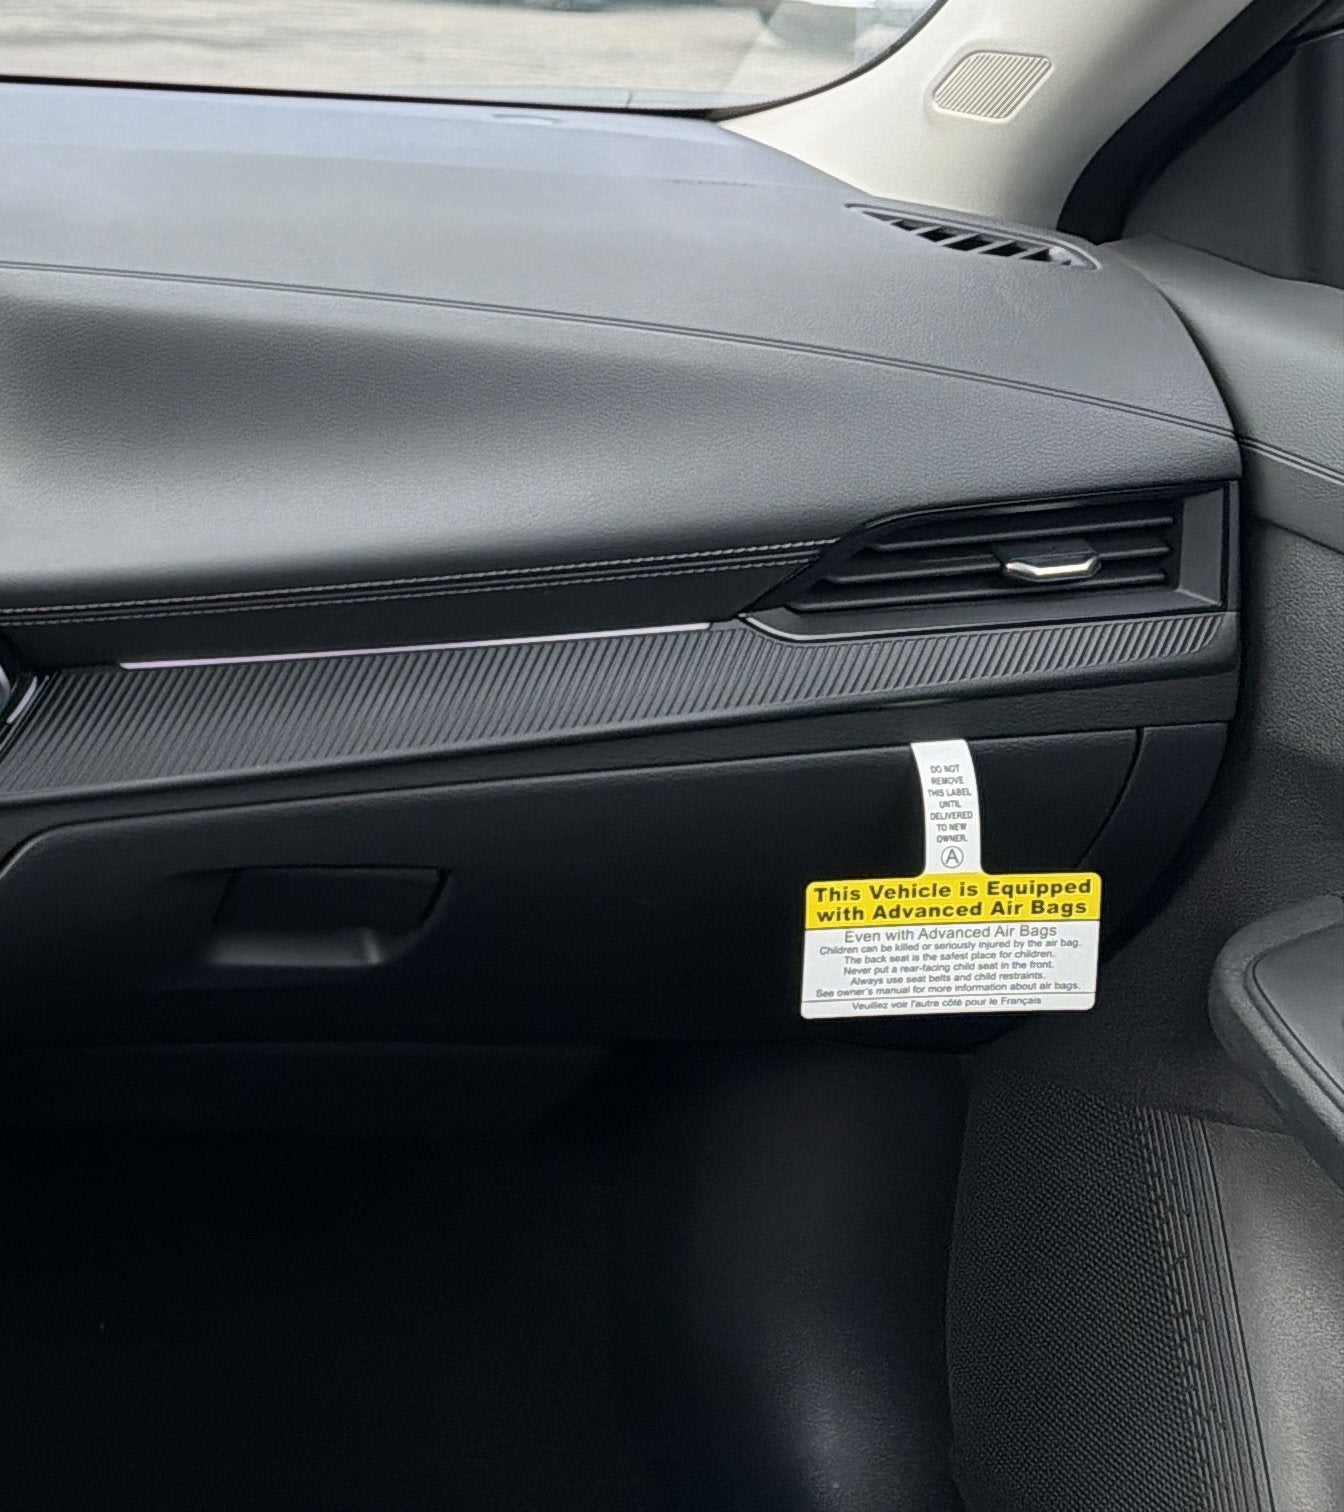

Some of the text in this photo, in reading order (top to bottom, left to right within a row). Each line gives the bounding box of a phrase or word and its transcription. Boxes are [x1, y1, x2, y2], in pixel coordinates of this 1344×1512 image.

[930, 764, 960, 773] DO NOT
[931, 776, 964, 785] REMOVE
[927, 787, 972, 797] THIS LABEL
[939, 800, 961, 808] UNTIL
[930, 810, 973, 820] DELIVERED
[936, 823, 967, 831] TO NEW
[945, 848, 960, 865] A
[814, 879, 1092, 902] This Vehicle is Equipped
[816, 899, 1087, 922] with Advanced Air Bags
[845, 924, 1057, 944] Even with Advanced Air Bags
[819, 945, 858, 955] Children
[861, 945, 878, 954] can
[881, 943, 892, 953] be
[895, 942, 919, 952] killed
[934, 941, 976, 951] seriously
[979, 939, 1011, 949] injured
[1013, 939, 1025, 950] by
[1027, 939, 1042, 947] the
[1045, 938, 1058, 947] air
[1060, 938, 1081, 949] bag.
[844, 949, 1055, 964] The back seat is the safest place for children.
[843, 967, 871, 976] Never
[874, 966, 889, 976] put
[900, 963, 951, 973] rear-facing
[953, 961, 975, 970] child
[978, 961, 998, 969] seat
[1001, 961, 1009, 969] in
[1012, 961, 1027, 969] the
[1029, 960, 1055, 968] front.
[850, 976, 883, 986] Always
[906, 975, 926, 983] seat
[928, 974, 951, 982] belts
[953, 973, 972, 981] and
[974, 972, 996, 981] child
[999, 971, 1046, 980] restraints.
[816, 981, 1081, 998] See owner's manual for more information about air bags.
[852, 1001, 888, 1010] Veuillez
[891, 1000, 908, 1008] voir
[965, 998, 987, 1007] pour
[989, 996, 998, 1005] le
[1000, 996, 1042, 1006] Français
